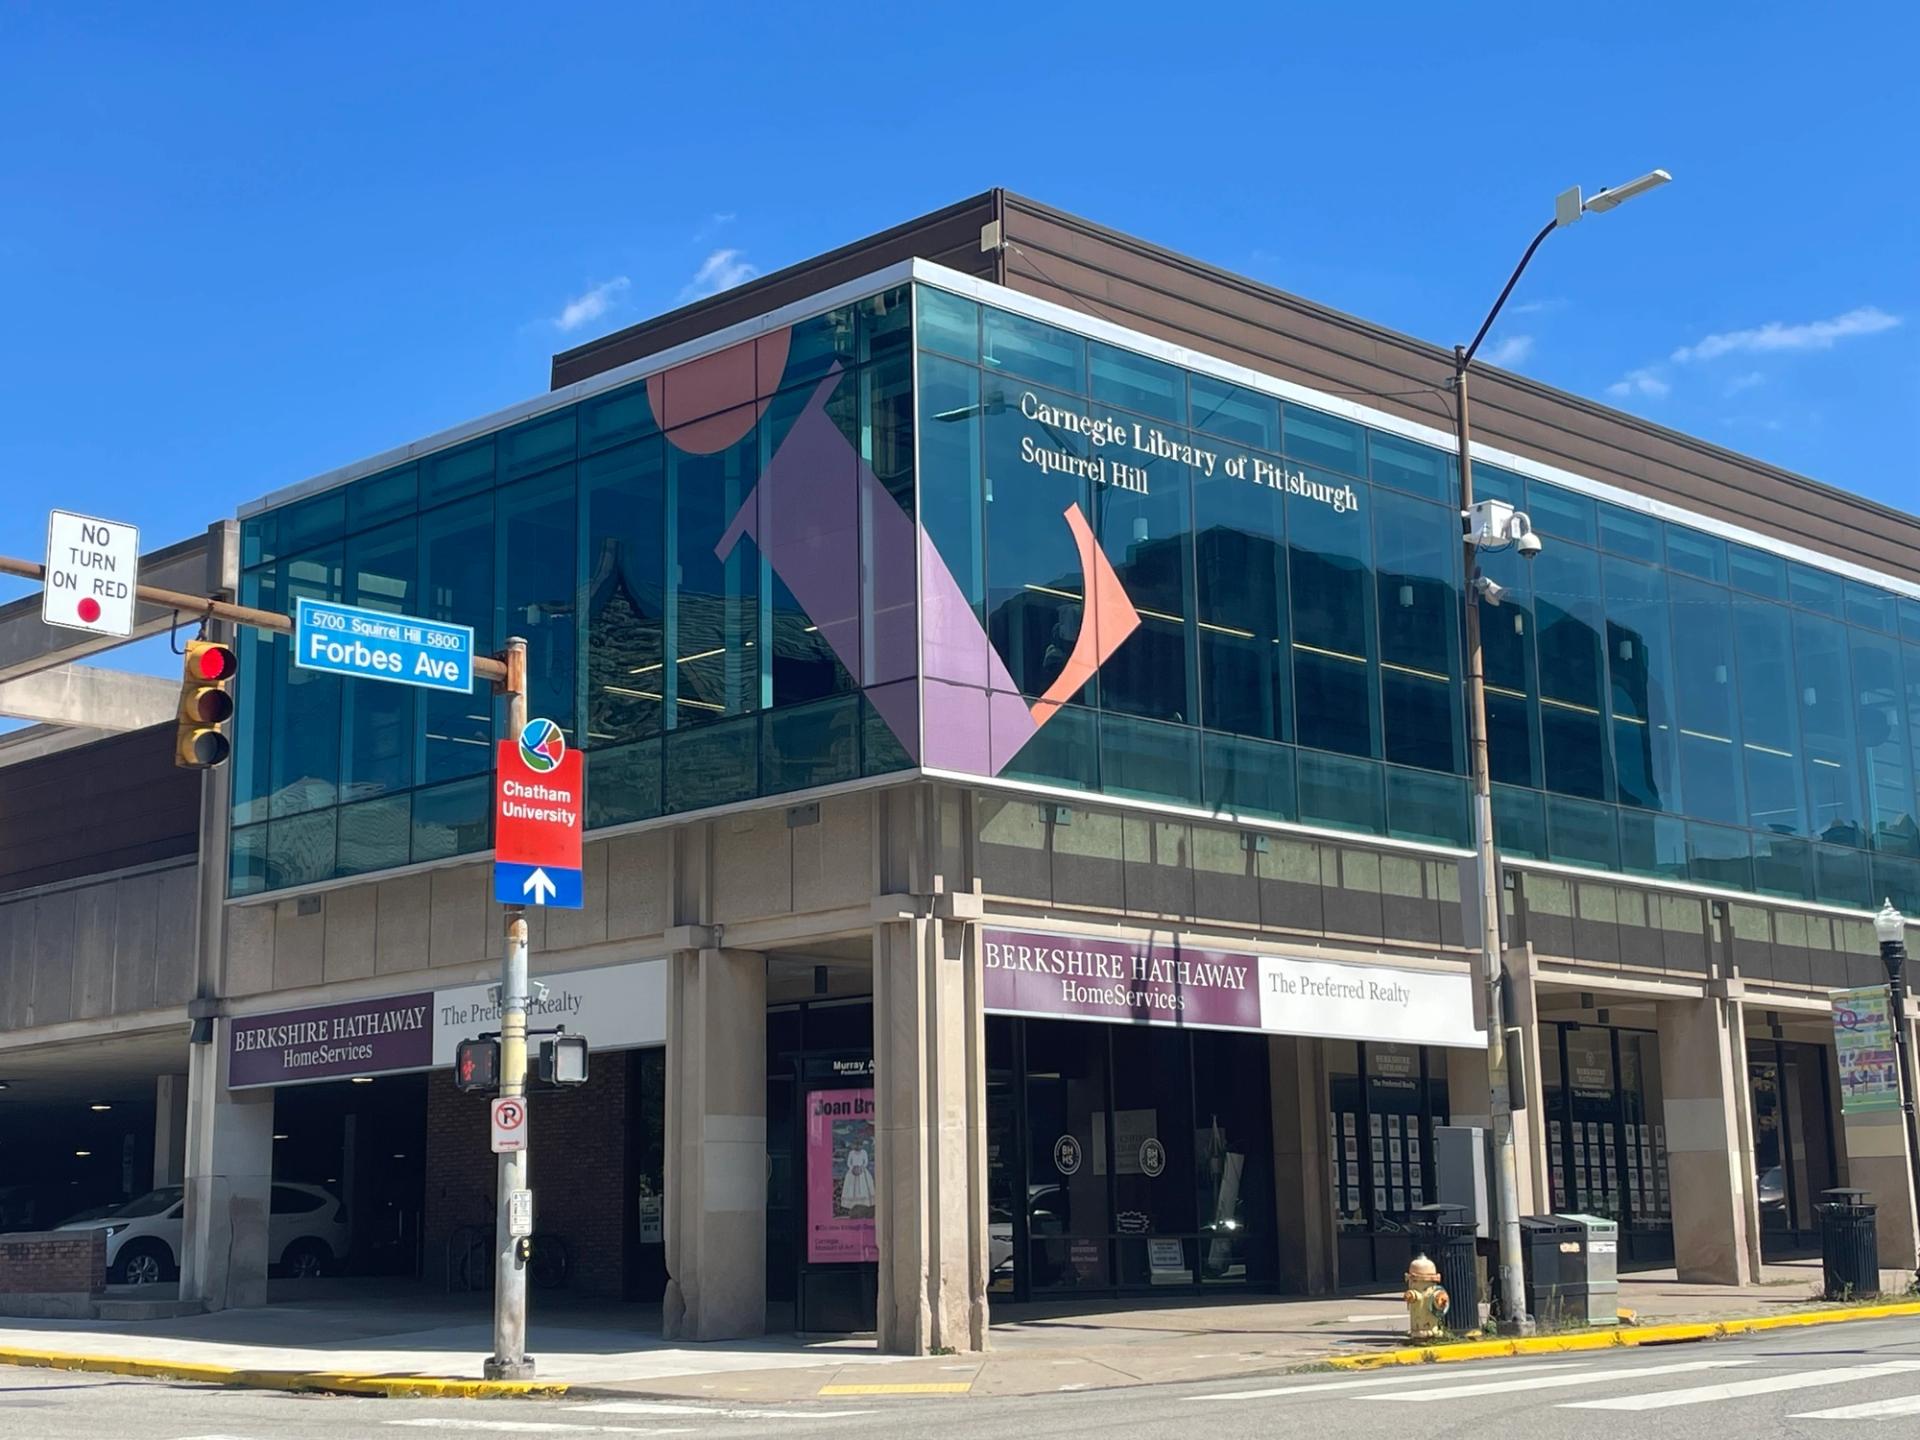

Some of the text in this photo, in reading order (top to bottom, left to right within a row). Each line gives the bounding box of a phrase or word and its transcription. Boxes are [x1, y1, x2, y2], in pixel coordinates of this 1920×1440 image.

[1021, 391, 1359, 513] Carnegie Library of Pittsburgh
[1021, 436, 1149, 495] Squirrel Hill
[81, 523, 111, 547] NO
[69, 547, 116, 572] TURN
[53, 570, 128, 599] ON RED
[312, 612, 460, 650] 5700 Squirrel Hill 5800
[310, 633, 460, 682] Forbes Ave
[503, 780, 571, 803] Chatham
[502, 800, 576, 828] University
[985, 942, 1248, 990] BERKSHIRE HATHAWAY
[1061, 979, 1186, 1010] HomeServices
[1268, 972, 1412, 1008] The Preferred Realty
[235, 1006, 427, 1052] BERKSHIRE HATHAWAY
[441, 1005, 468, 1026] The
[283, 1041, 374, 1069] HomeServices
[833, 1060, 865, 1071] Murray
[815, 1098, 875, 1116] Joan Br
